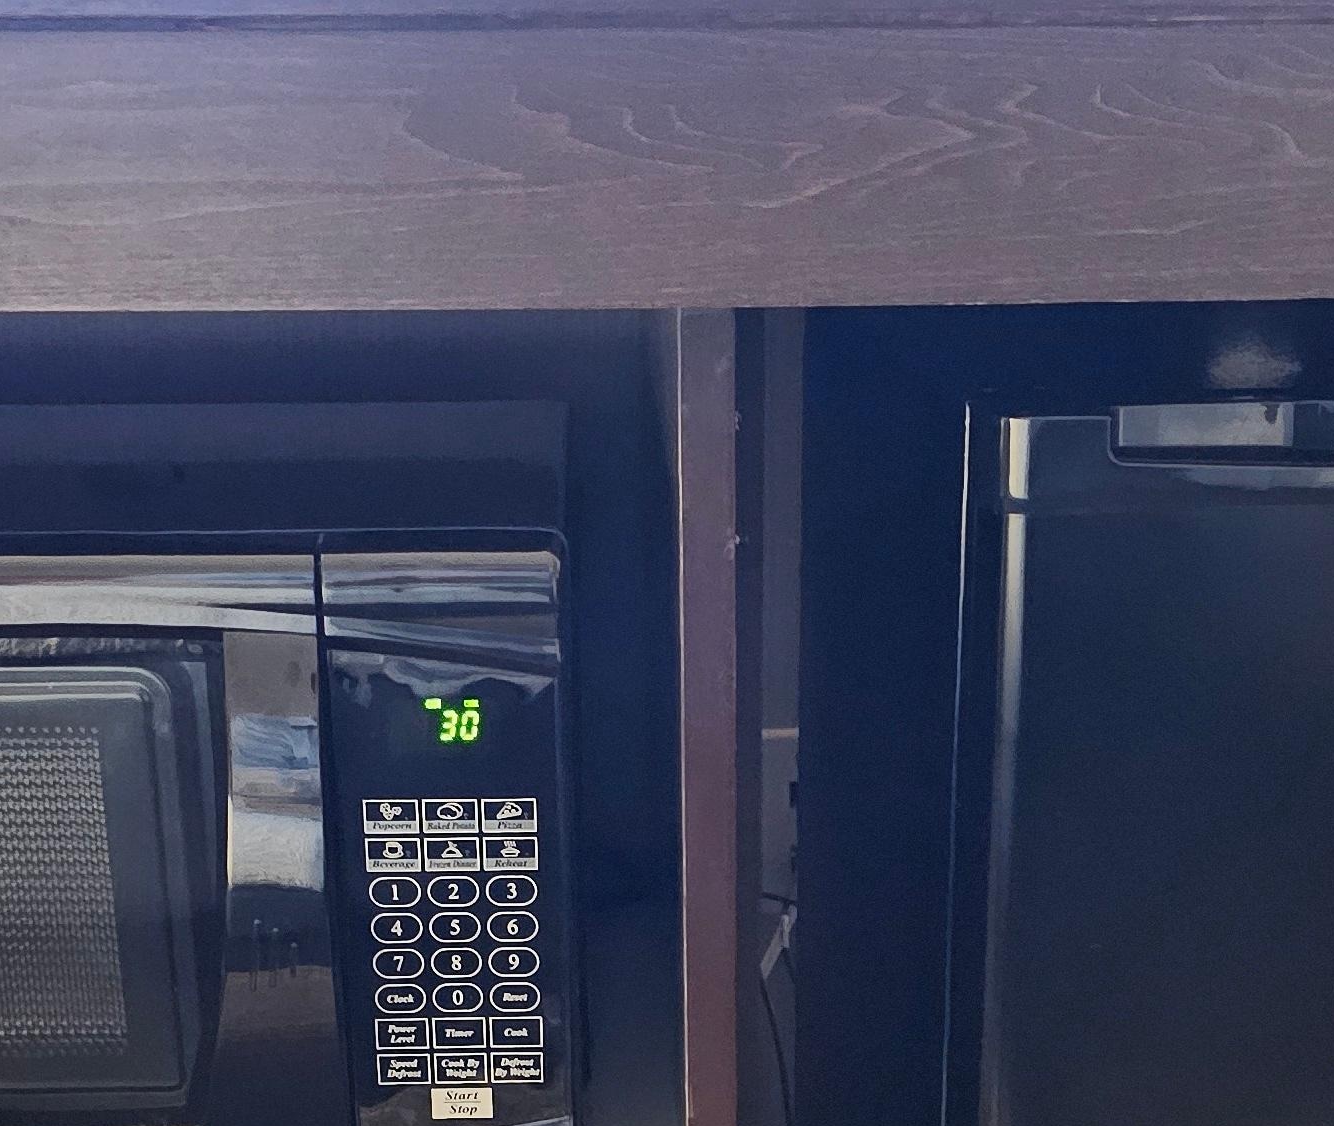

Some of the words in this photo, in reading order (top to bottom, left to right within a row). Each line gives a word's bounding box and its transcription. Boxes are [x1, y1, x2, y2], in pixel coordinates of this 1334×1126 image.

[372, 821, 412, 831] Popcorn
[427, 821, 450, 830] Baked
[496, 821, 523, 830] Pizza
[372, 860, 416, 869] Beverage
[494, 859, 527, 868] Reheat
[391, 884, 399, 901] 1
[447, 883, 460, 900] 2
[506, 882, 518, 899] 3
[390, 919, 403, 936] 4
[449, 919, 461, 936] 5
[506, 918, 519, 935] 6
[392, 955, 404, 972] 7
[450, 954, 462, 971] 8
[508, 953, 520, 970] 9
[386, 994, 414, 1004] Clock
[452, 989, 464, 1006] 0
[502, 992, 528, 1002] Reset
[388, 1024, 417, 1034] Power
[444, 1028, 474, 1038] Timer
[503, 1028, 528, 1037] Cook
[390, 1034, 415, 1044] Level
[389, 1059, 418, 1069] Speed
[441, 1058, 465, 1068] Cook
[467, 1058, 480, 1069] By
[501, 1057, 534, 1067] Defrost
[387, 1069, 421, 1079] Defrost
[446, 1068, 477, 1079] Weight
[495, 1067, 507, 1077] By
[510, 1067, 540, 1077] Weight
[446, 1090, 479, 1100] Start
[450, 1105, 478, 1116] Stop
